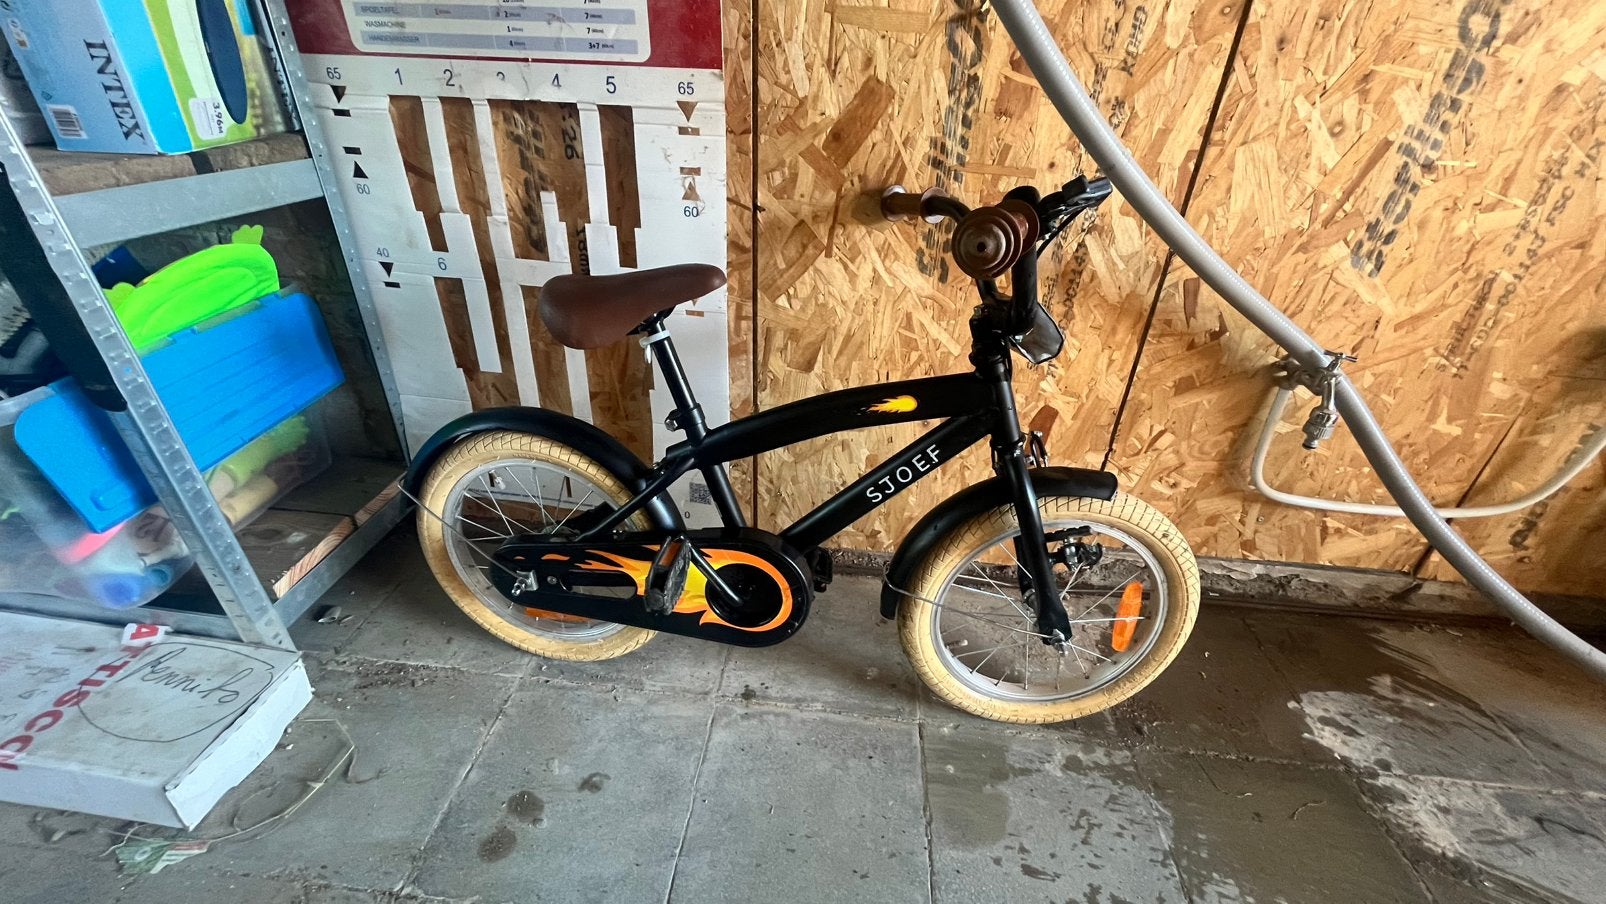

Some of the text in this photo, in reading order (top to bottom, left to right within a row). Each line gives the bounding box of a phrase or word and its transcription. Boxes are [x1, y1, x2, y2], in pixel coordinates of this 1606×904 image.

[83, 38, 145, 142] INTEX
[326, 66, 342, 80] 65
[394, 68, 403, 86] 1
[443, 69, 456, 87] 2
[551, 73, 562, 90] 4
[605, 76, 617, 94] 5
[677, 81, 695, 96] 65
[356, 183, 700, 218] 60 60
[376, 247, 447, 271] 40 6
[866, 443, 940, 503] SJOEF
